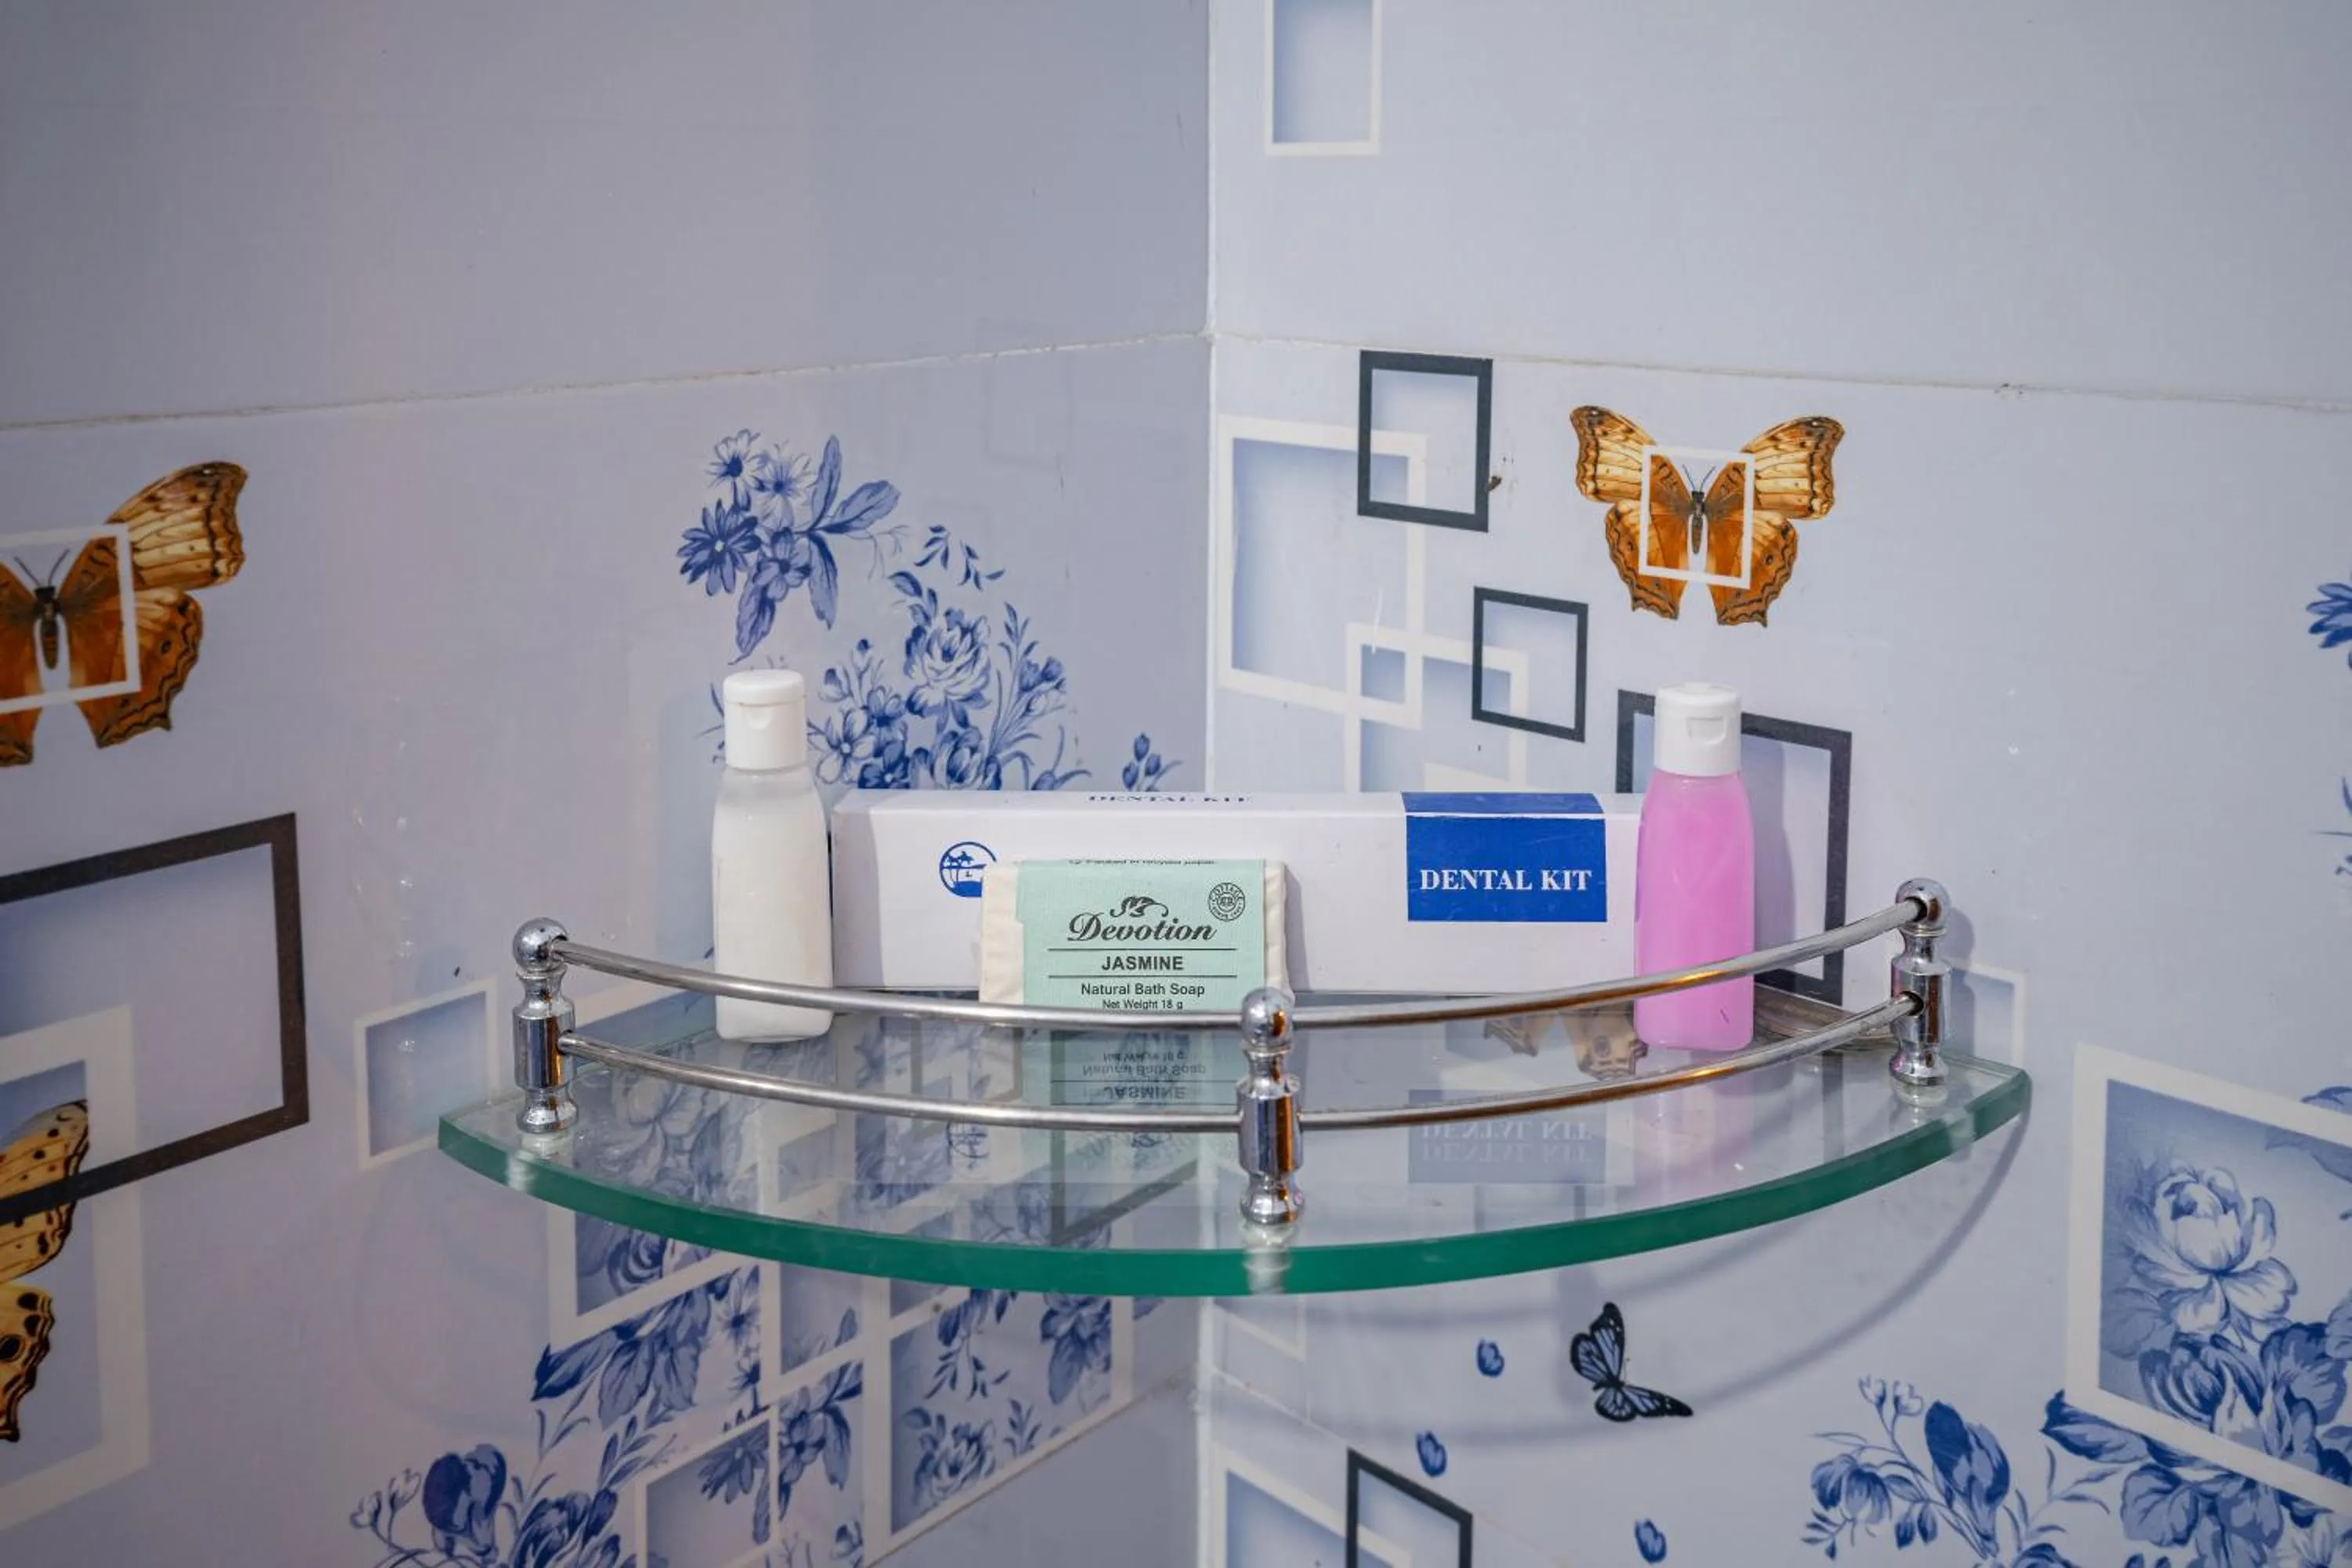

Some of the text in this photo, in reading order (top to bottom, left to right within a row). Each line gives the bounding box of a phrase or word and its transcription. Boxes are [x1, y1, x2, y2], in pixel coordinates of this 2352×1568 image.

[1420, 869, 1592, 891] DENTAL KIT
[1067, 911, 1218, 942] Devotion
[1102, 956, 1185, 971] JASMINE
[1080, 983, 1205, 998] Natural Bath Soap
[1102, 999, 1184, 1011] Net Weight 18 g
